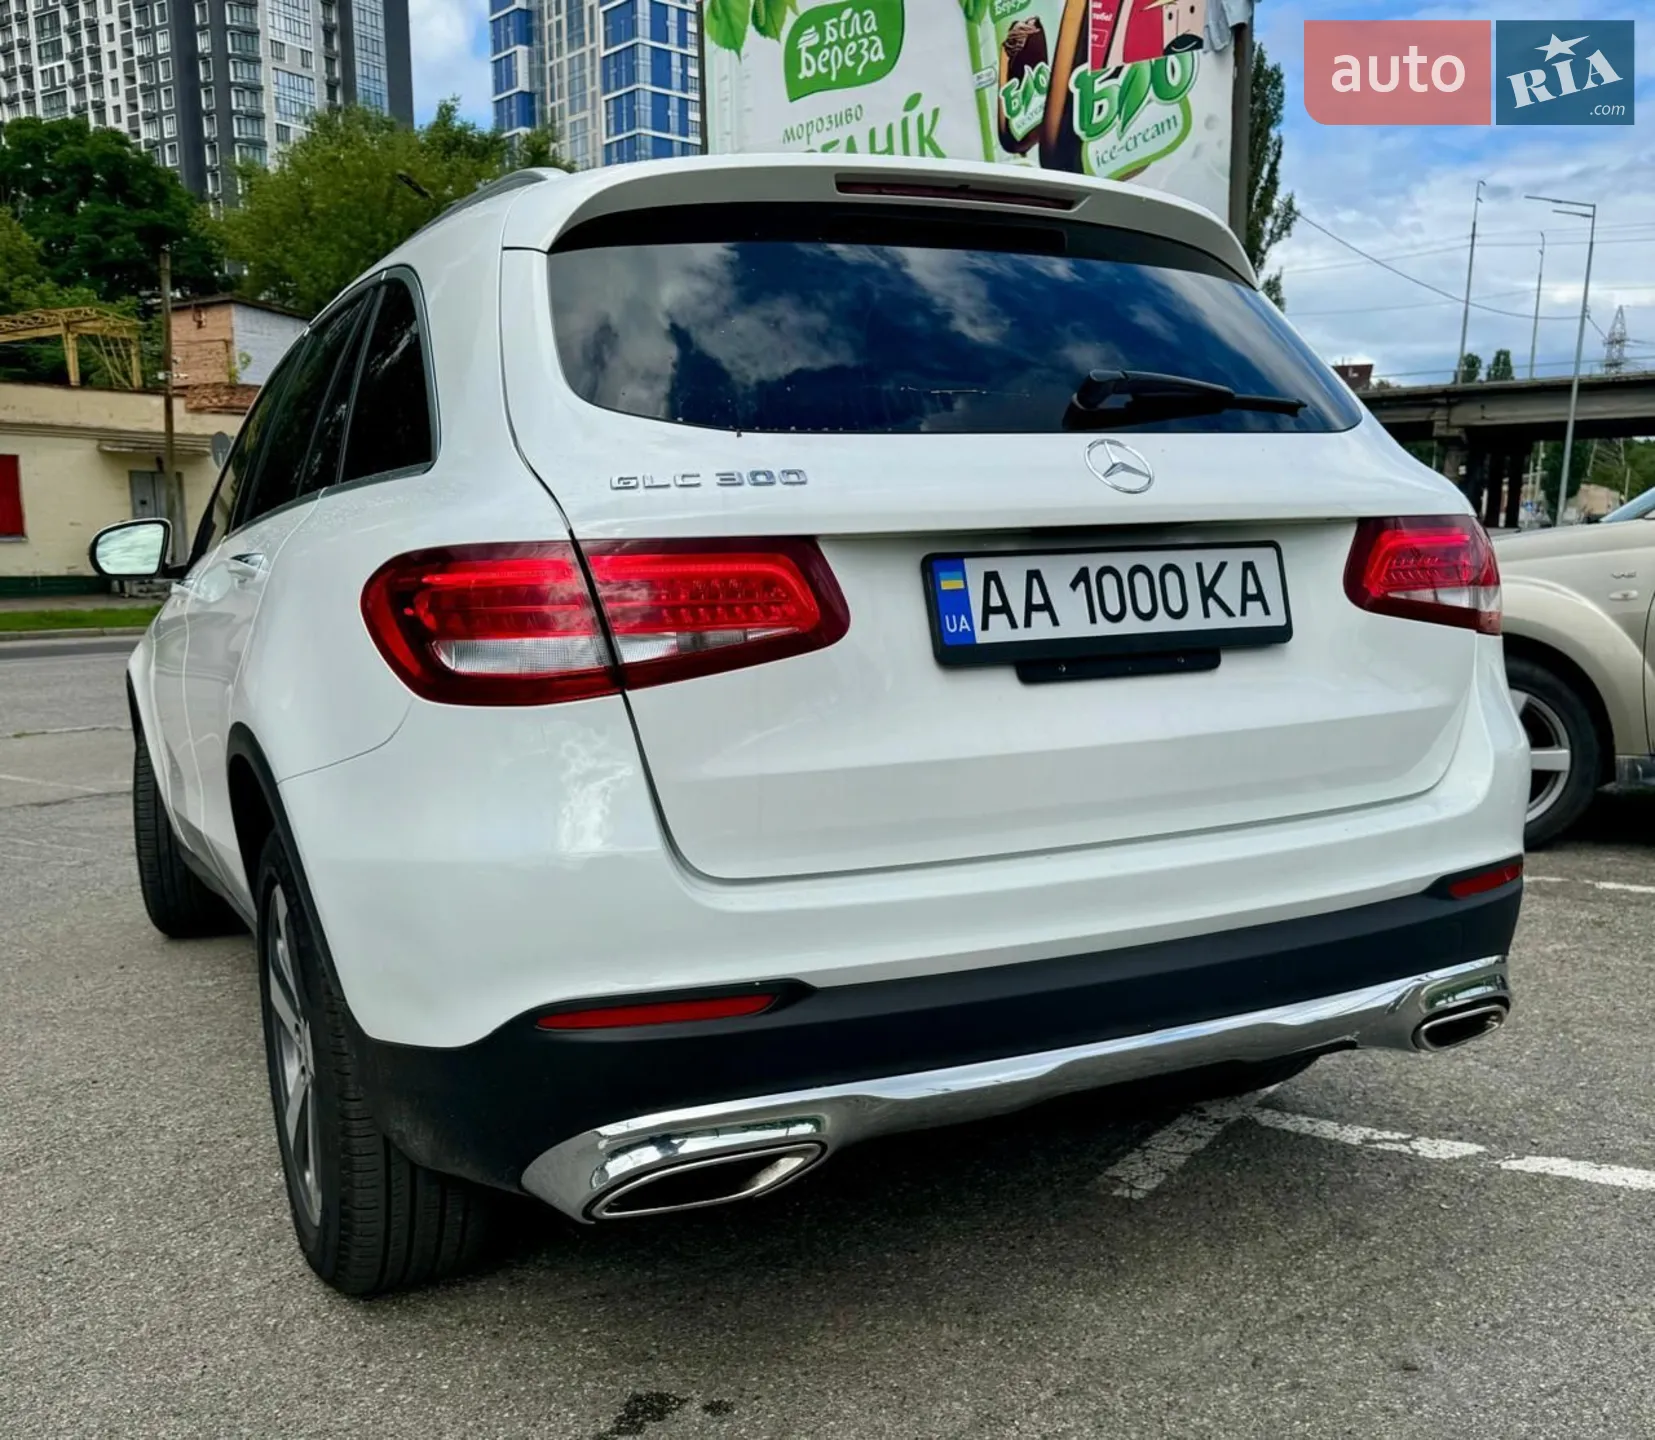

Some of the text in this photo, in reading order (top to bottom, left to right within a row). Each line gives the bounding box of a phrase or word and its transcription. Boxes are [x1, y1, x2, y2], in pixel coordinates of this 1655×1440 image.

[823, 8, 878, 45] Біла
[797, 27, 886, 81] Береза
[781, 104, 865, 145] морозиво
[1095, 115, 1179, 168] ice-cream
[610, 469, 808, 490] GLC 300
[980, 560, 1272, 632] AA 1000 KA
[945, 614, 972, 634] UA
